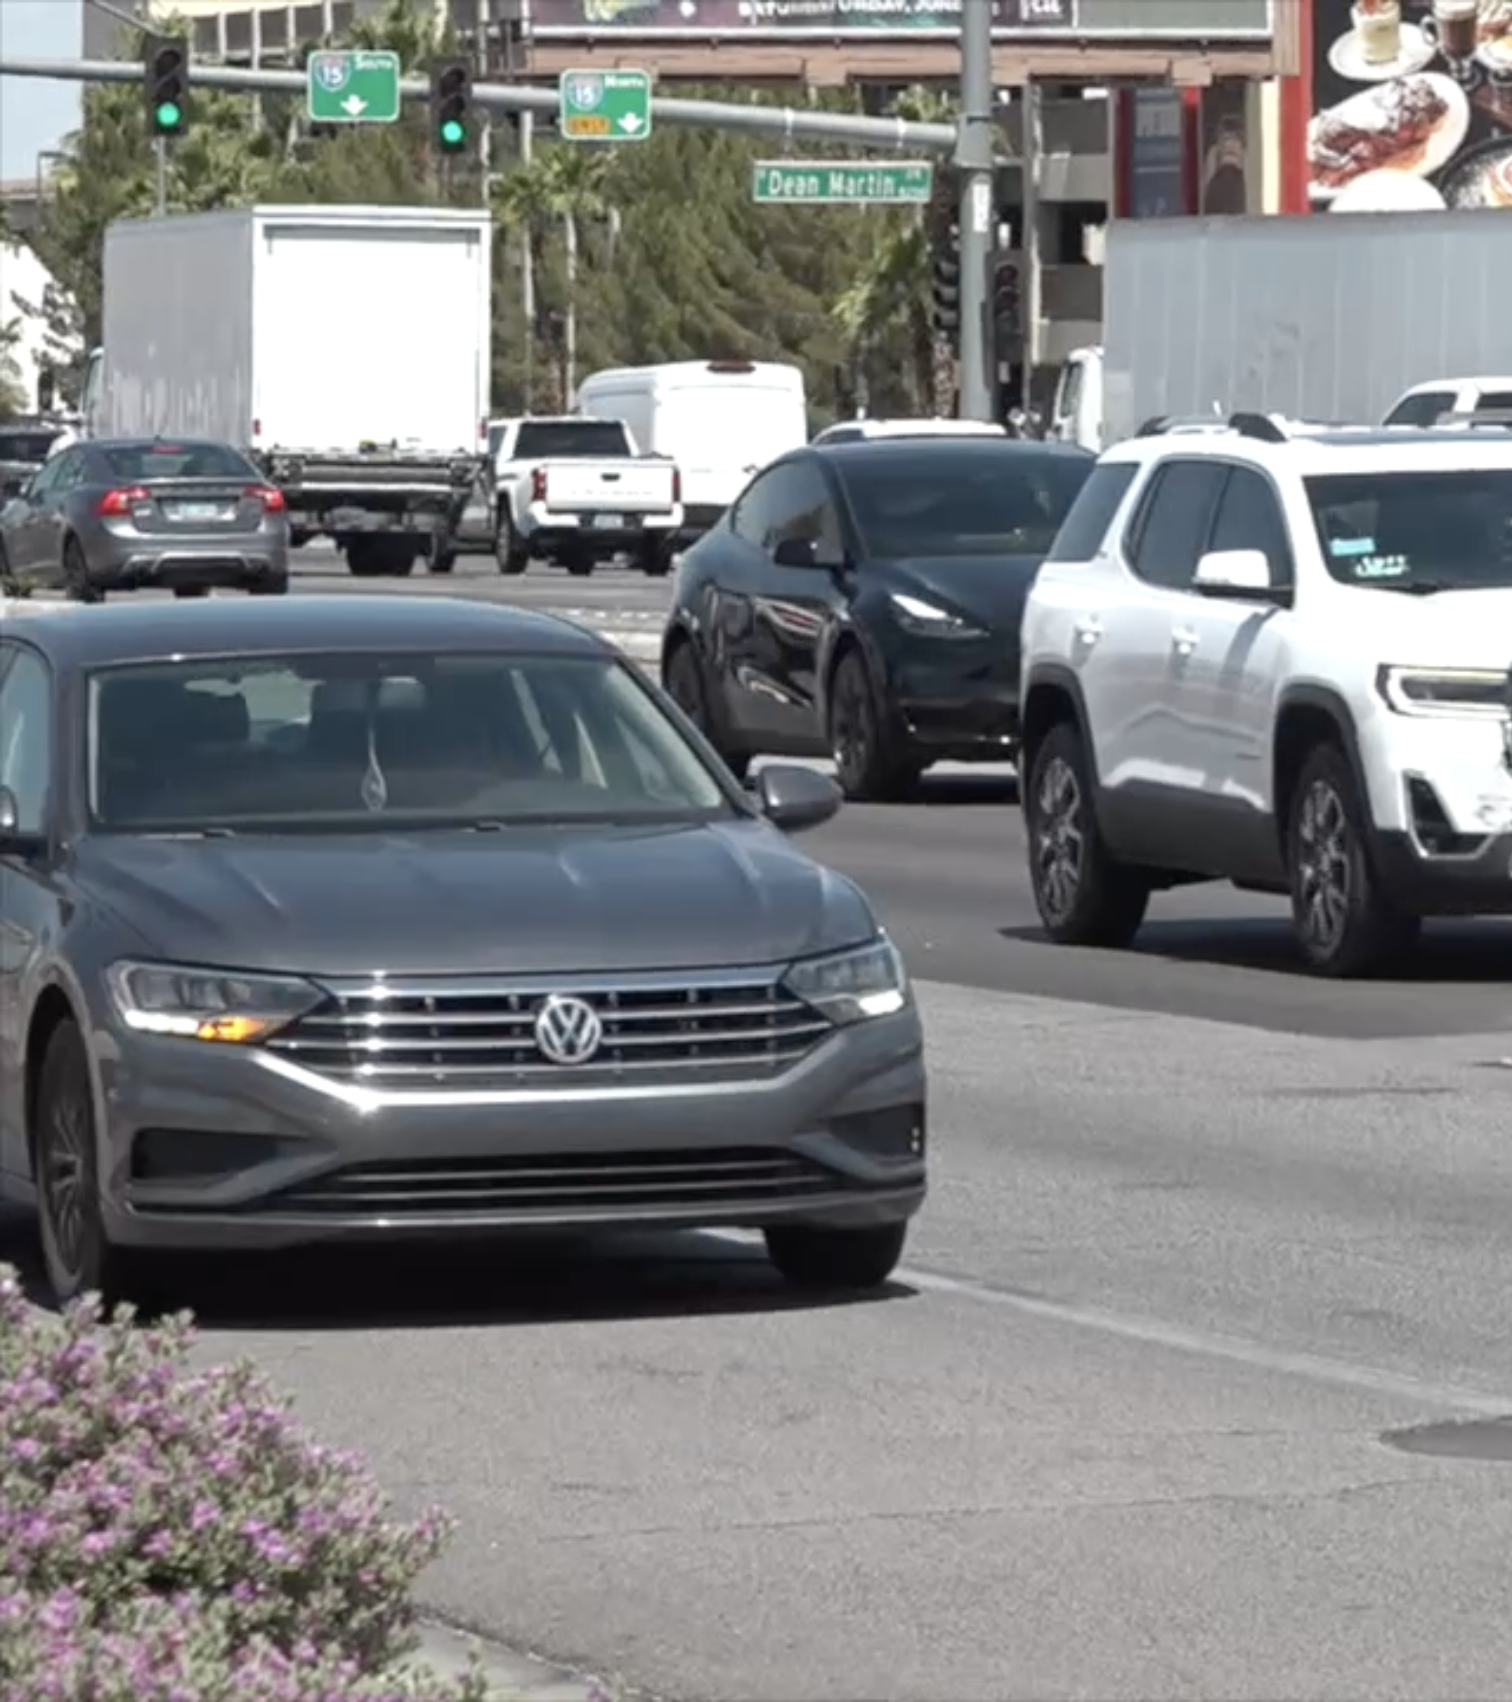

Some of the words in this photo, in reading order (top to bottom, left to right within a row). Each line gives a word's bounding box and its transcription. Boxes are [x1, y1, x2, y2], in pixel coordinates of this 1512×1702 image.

[323, 66, 343, 83] 15
[575, 86, 595, 103] 15
[769, 170, 818, 195] Dean
[829, 171, 896, 195] Martin
